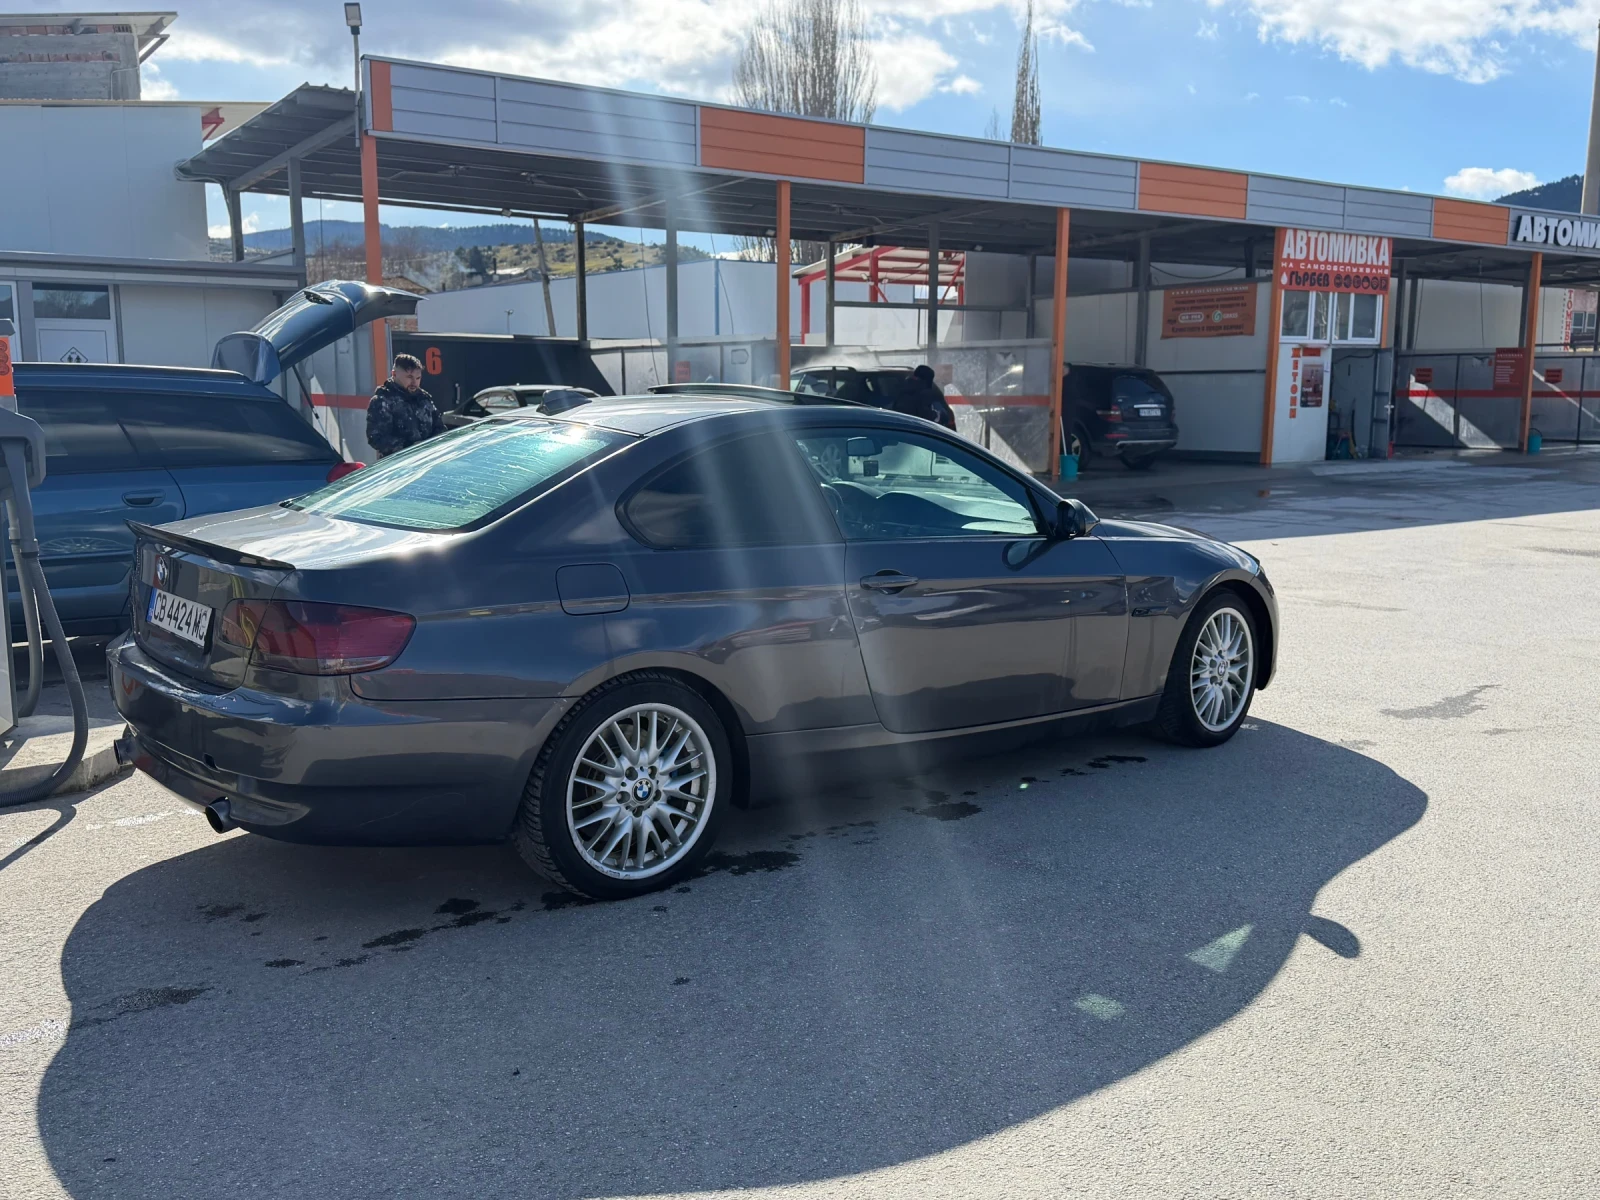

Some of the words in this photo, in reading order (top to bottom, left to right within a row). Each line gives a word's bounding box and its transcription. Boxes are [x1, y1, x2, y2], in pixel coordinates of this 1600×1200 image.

[1281, 228, 1389, 266] АВТОМИВКА
[1289, 271, 1330, 288] ГЪРБЕВ
[425, 346, 442, 375] 6
[154, 592, 167, 622] CB
[167, 598, 193, 634] 4424
